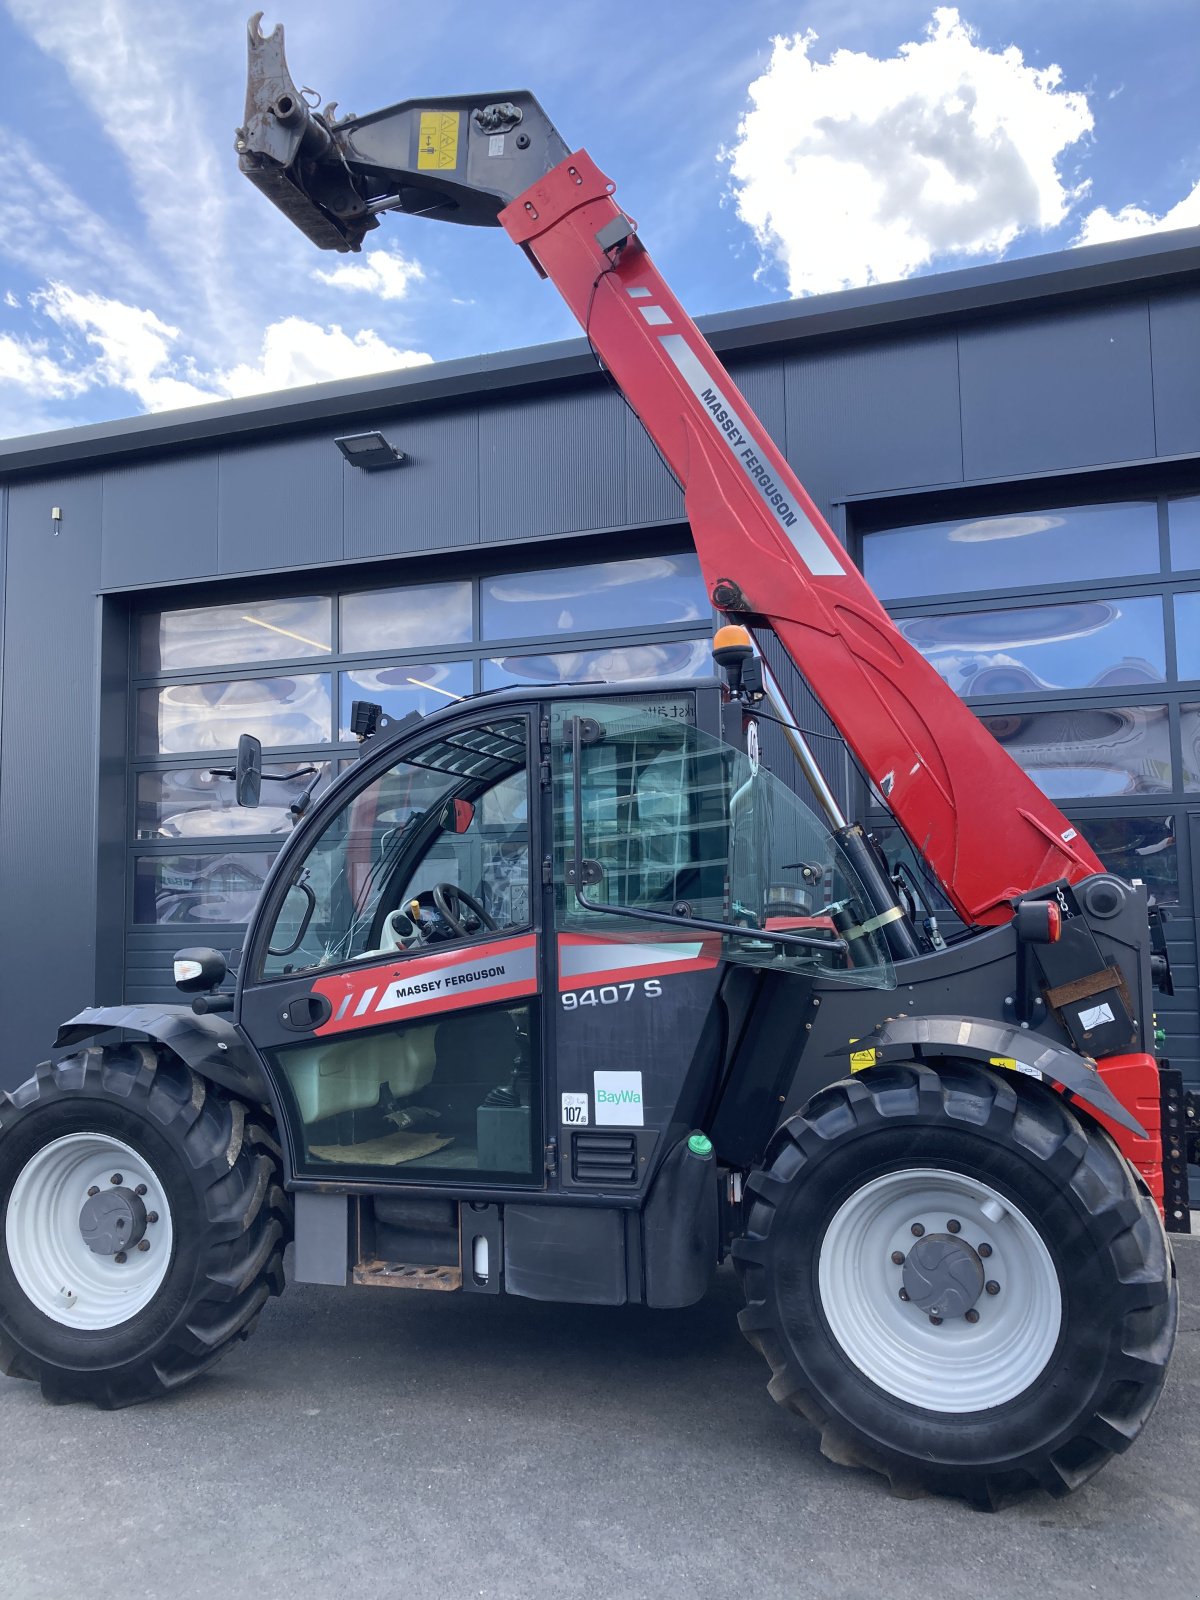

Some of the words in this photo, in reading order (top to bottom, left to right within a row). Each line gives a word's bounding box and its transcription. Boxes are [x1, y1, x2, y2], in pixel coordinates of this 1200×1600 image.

[701, 388, 746, 447] MASSEY
[741, 448, 797, 527] FERGUSON
[396, 981, 441, 998] MASSEY
[445, 965, 505, 988] FERGUSON
[561, 983, 635, 1011] 9407
[644, 979, 662, 998] S
[597, 1090, 641, 1105] BayWa
[564, 1107, 581, 1122] 107
